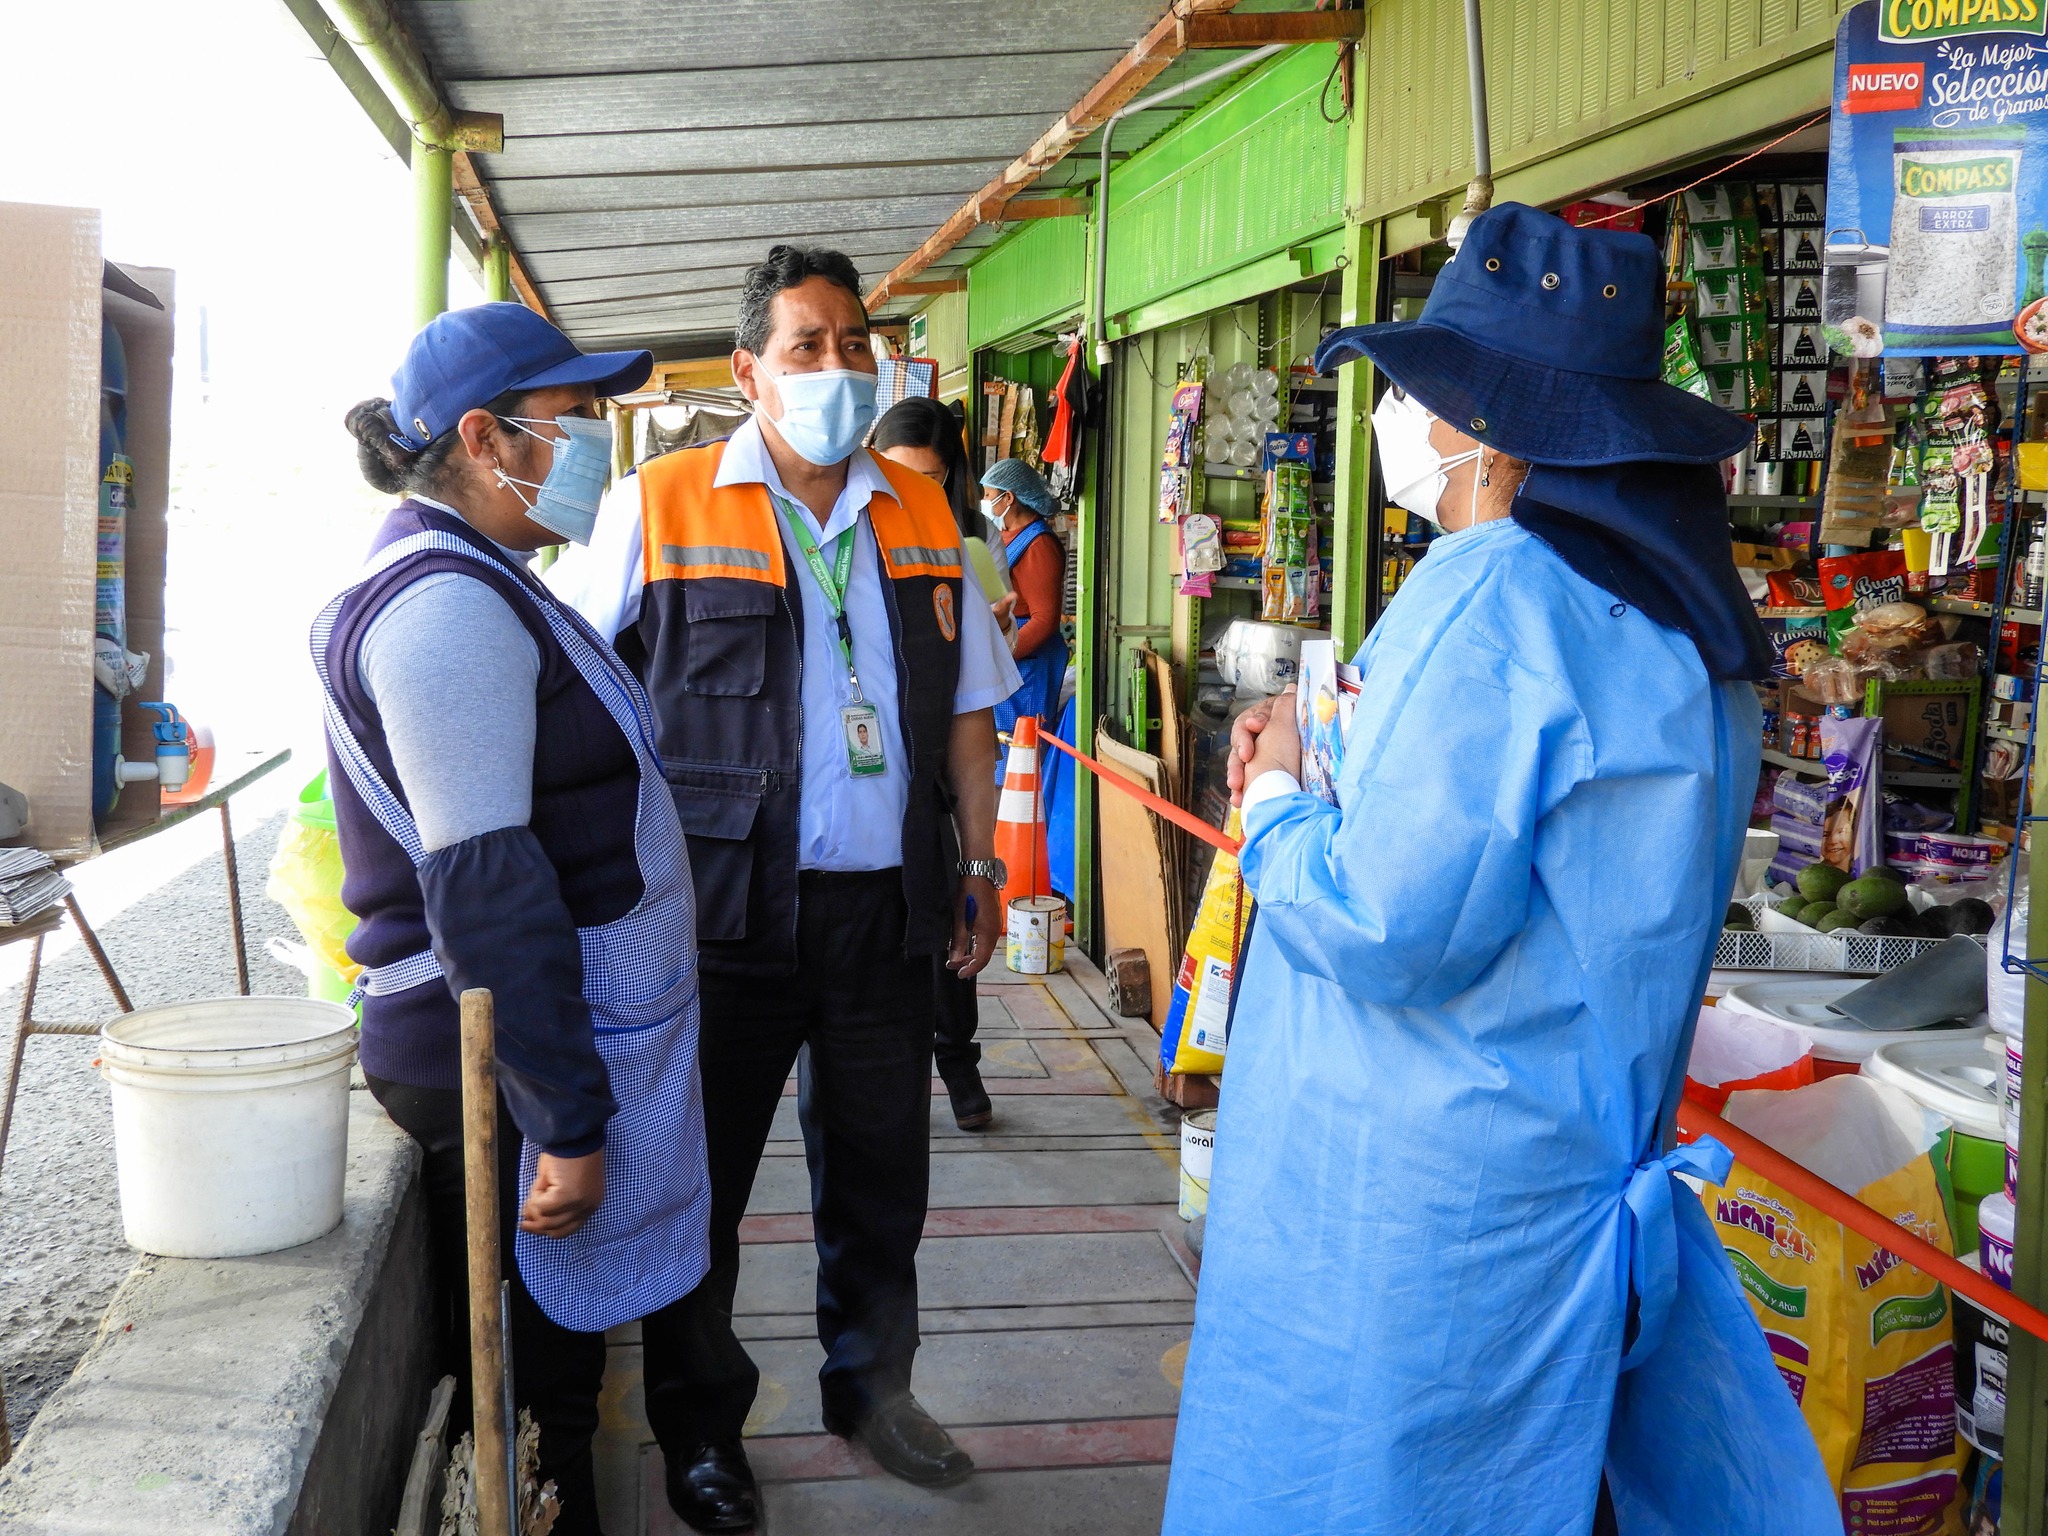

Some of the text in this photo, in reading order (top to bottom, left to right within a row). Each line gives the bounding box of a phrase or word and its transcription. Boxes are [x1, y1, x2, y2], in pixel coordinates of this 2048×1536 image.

[1888, 0, 2038, 38] COMPASS
[1949, 43, 2035, 71] La Mejor
[1851, 73, 1920, 92] NUEVO
[1969, 101, 1990, 121] de
[1905, 162, 2009, 197] COMPASS
[1934, 209, 1975, 220] ARROZ
[1935, 220, 1974, 229] EXTRA
[1952, 847, 1987, 861] NOBLE
[1744, 1273, 1770, 1300] Sardina
[1770, 1297, 1778, 1306] y
